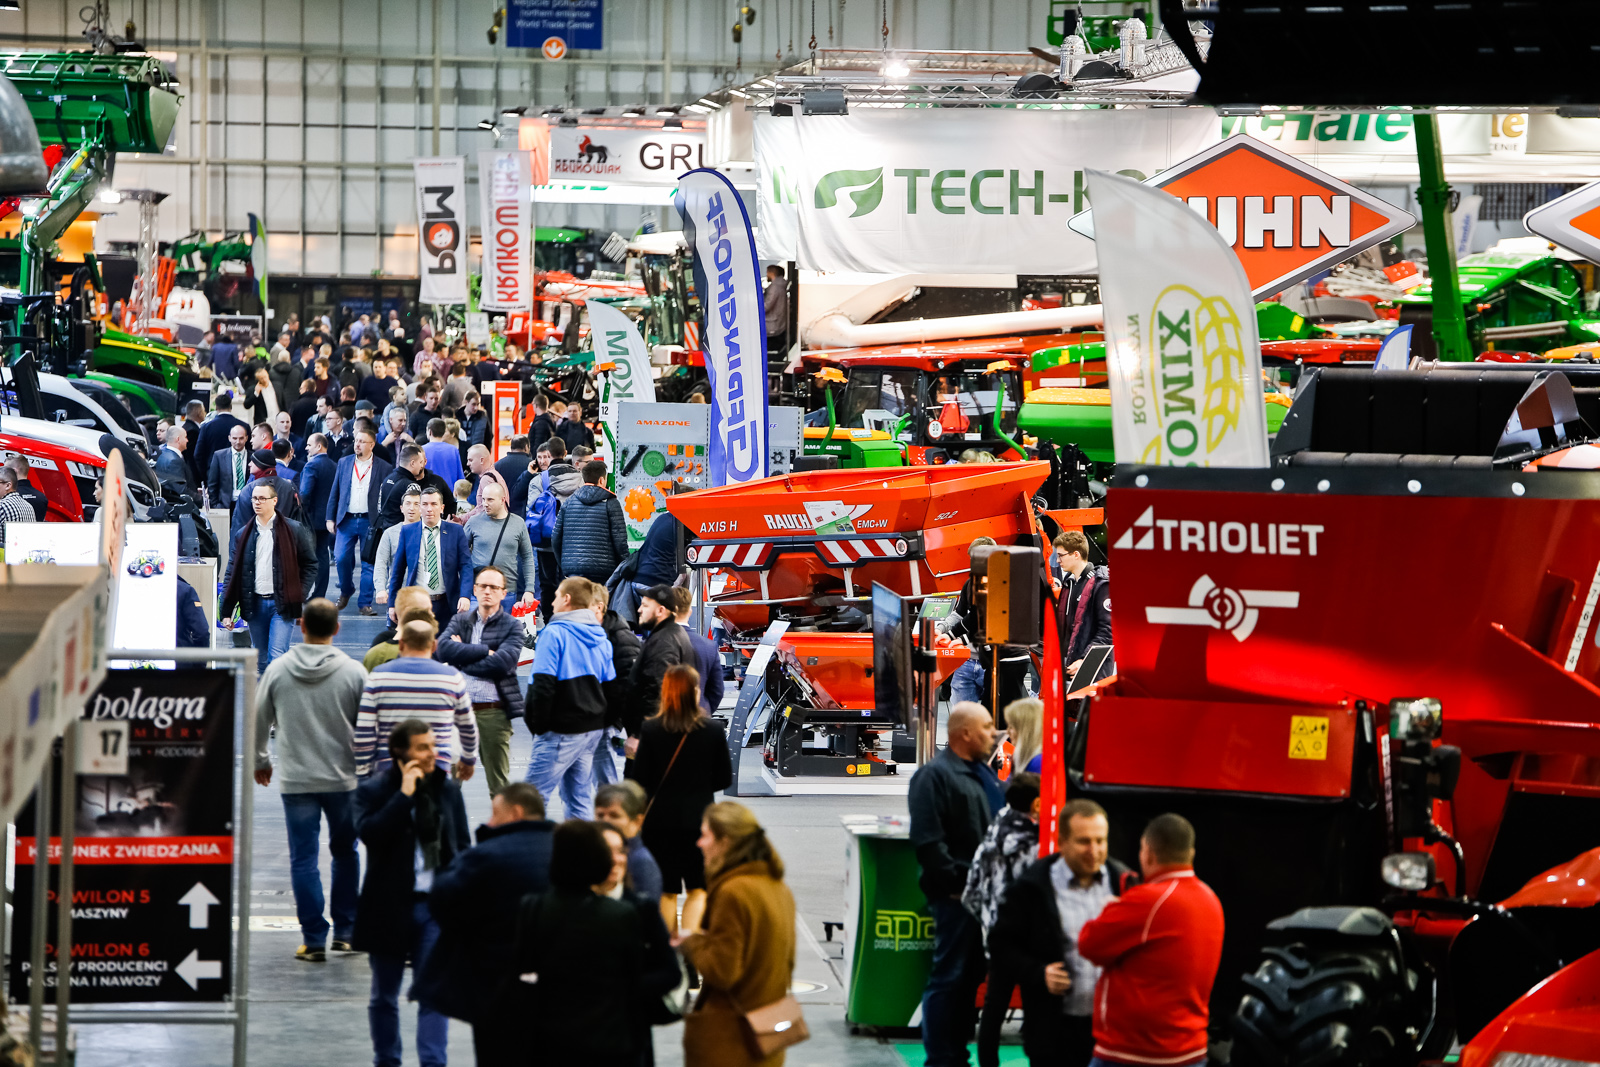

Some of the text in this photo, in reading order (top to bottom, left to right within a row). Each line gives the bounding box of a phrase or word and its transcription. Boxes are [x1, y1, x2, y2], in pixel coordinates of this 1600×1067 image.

[515, 20, 595, 29] World Trade Center
[555, 160, 622, 174] KRUKOWIAK
[1174, 195, 1351, 247] UHN
[601, 406, 609, 415] 12
[700, 520, 738, 533] AXIS H
[764, 514, 812, 529] RAUCH
[857, 519, 888, 529] EMC+W
[1156, 519, 1325, 556] TRIOLIET
[91, 686, 207, 729] polagra
[101, 729, 123, 757] 17
[115, 843, 221, 858] ZWIEDZANIA
[140, 890, 150, 904] 5
[138, 942, 150, 957] 6
[78, 960, 168, 973] PRODUCENCI
[100, 976, 162, 988] NAWOZY
